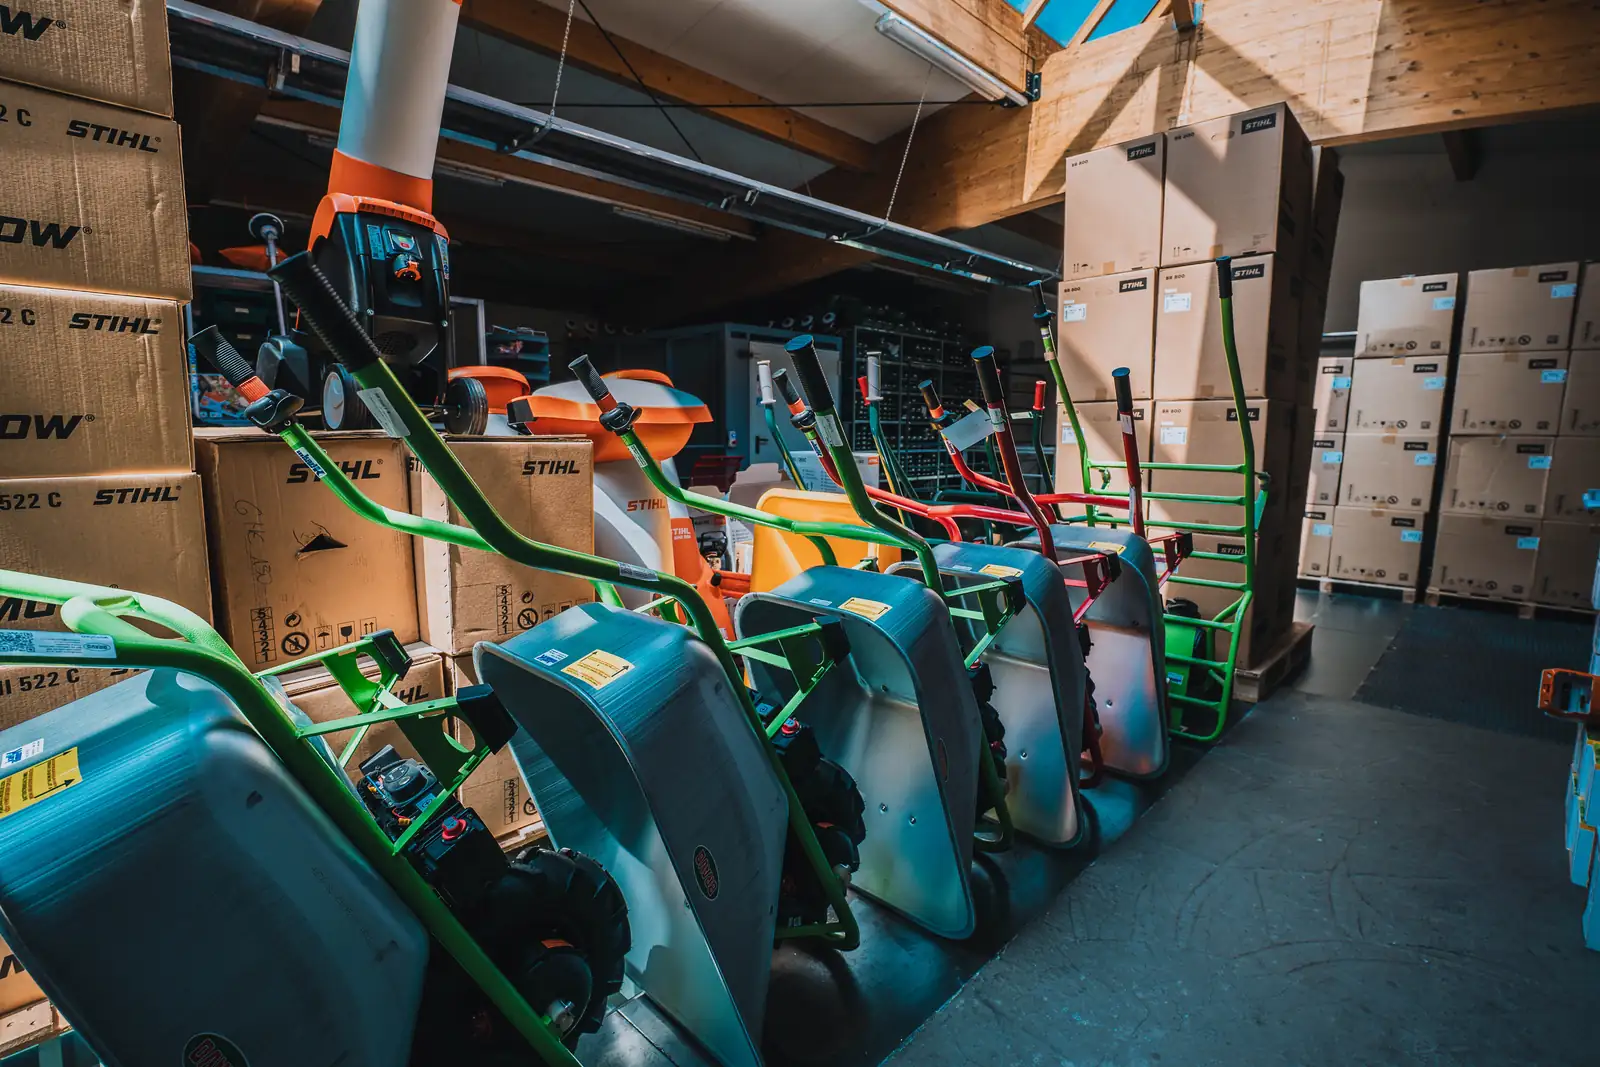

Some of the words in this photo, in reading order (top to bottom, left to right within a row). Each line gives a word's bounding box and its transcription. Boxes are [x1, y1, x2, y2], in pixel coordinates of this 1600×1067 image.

[17, 108, 32, 127] C
[1245, 119, 1272, 130] STIHL
[1130, 148, 1153, 158] STIHL
[1234, 268, 1260, 277] STIHL
[1122, 281, 1145, 290] STIHL
[21, 309, 36, 326] C
[521, 460, 580, 476] STIHL
[0, 493, 41, 511] 522
[48, 492, 62, 508] C
[93, 486, 180, 505] STIHL
[627, 498, 666, 512] STIHL
[19, 671, 60, 692] 522
[66, 667, 80, 684] C
